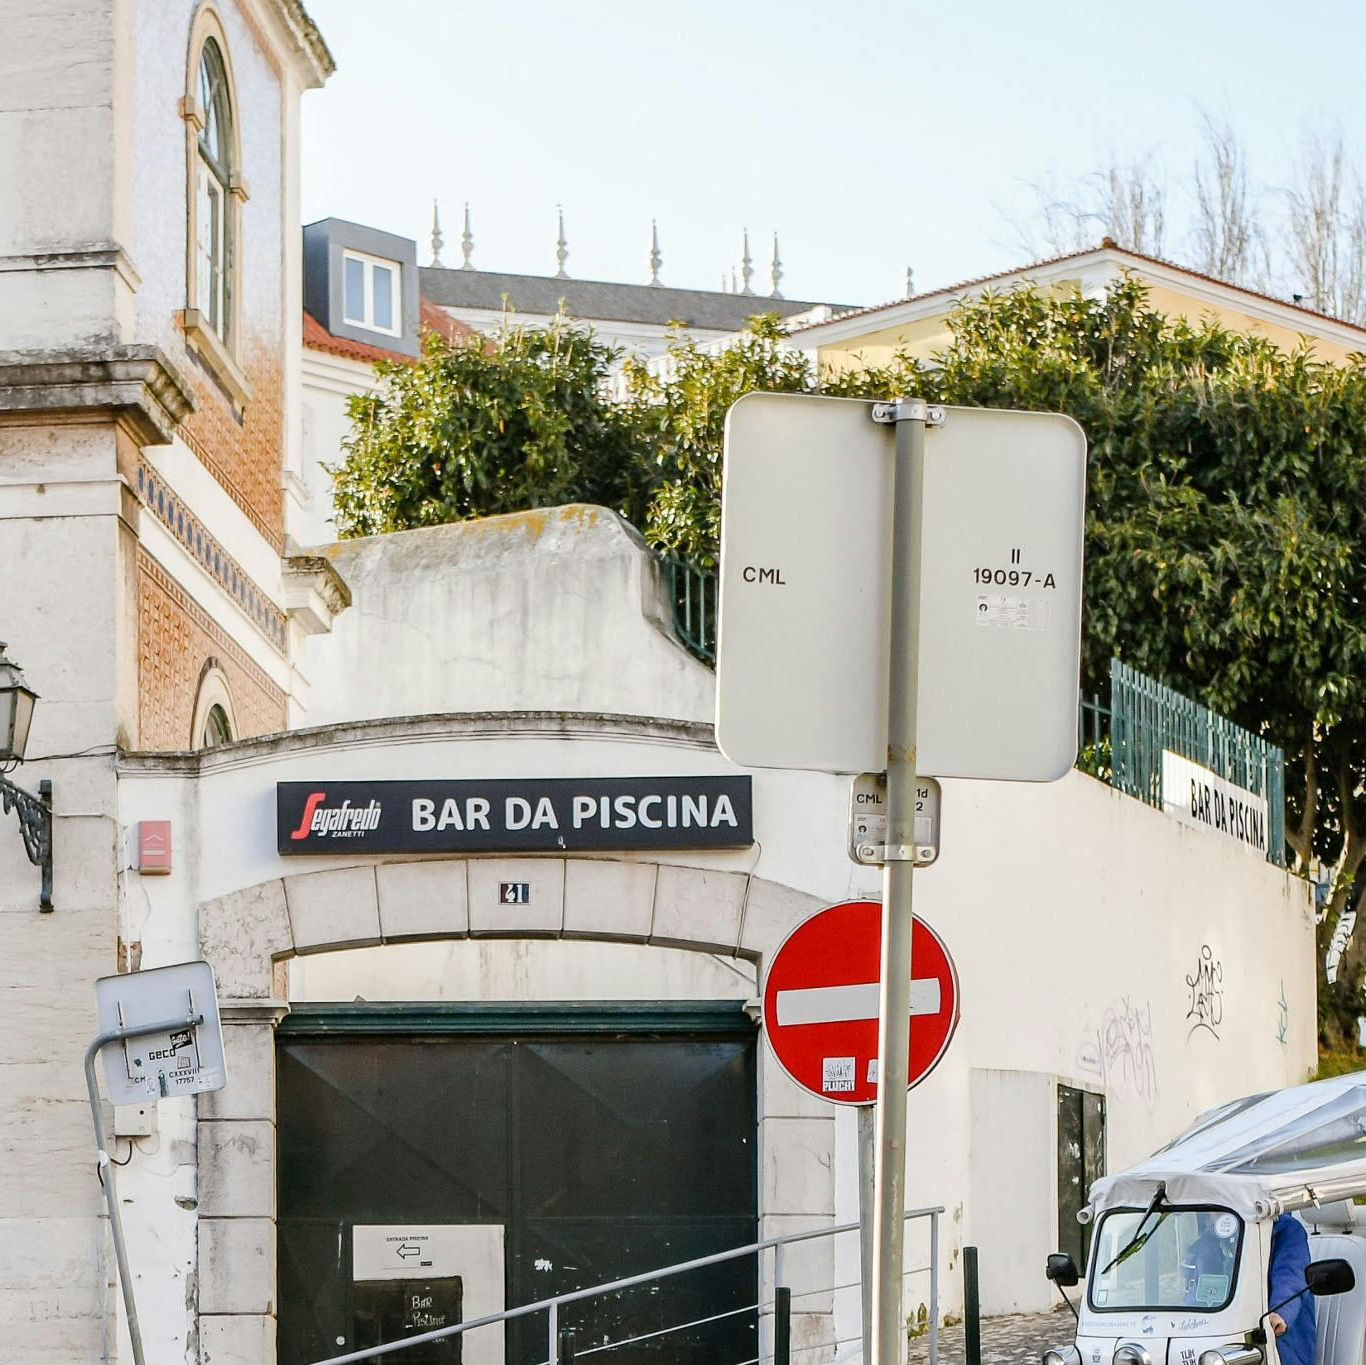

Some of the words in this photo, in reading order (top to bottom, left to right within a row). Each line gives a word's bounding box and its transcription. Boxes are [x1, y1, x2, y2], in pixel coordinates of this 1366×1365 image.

[742, 566, 786, 585] CML
[973, 567, 1056, 589] 19097-A
[856, 793, 882, 804] CML
[291, 793, 382, 839] Segafredo
[411, 797, 491, 832] BAR
[505, 797, 559, 831] DA
[572, 794, 739, 830] PISCINA
[1191, 778, 1212, 826] BAR
[1214, 788, 1228, 833] DA
[1229, 796, 1265, 852] PISCINA
[331, 830, 365, 838] ZANETTI
[505, 883, 524, 903] 41
